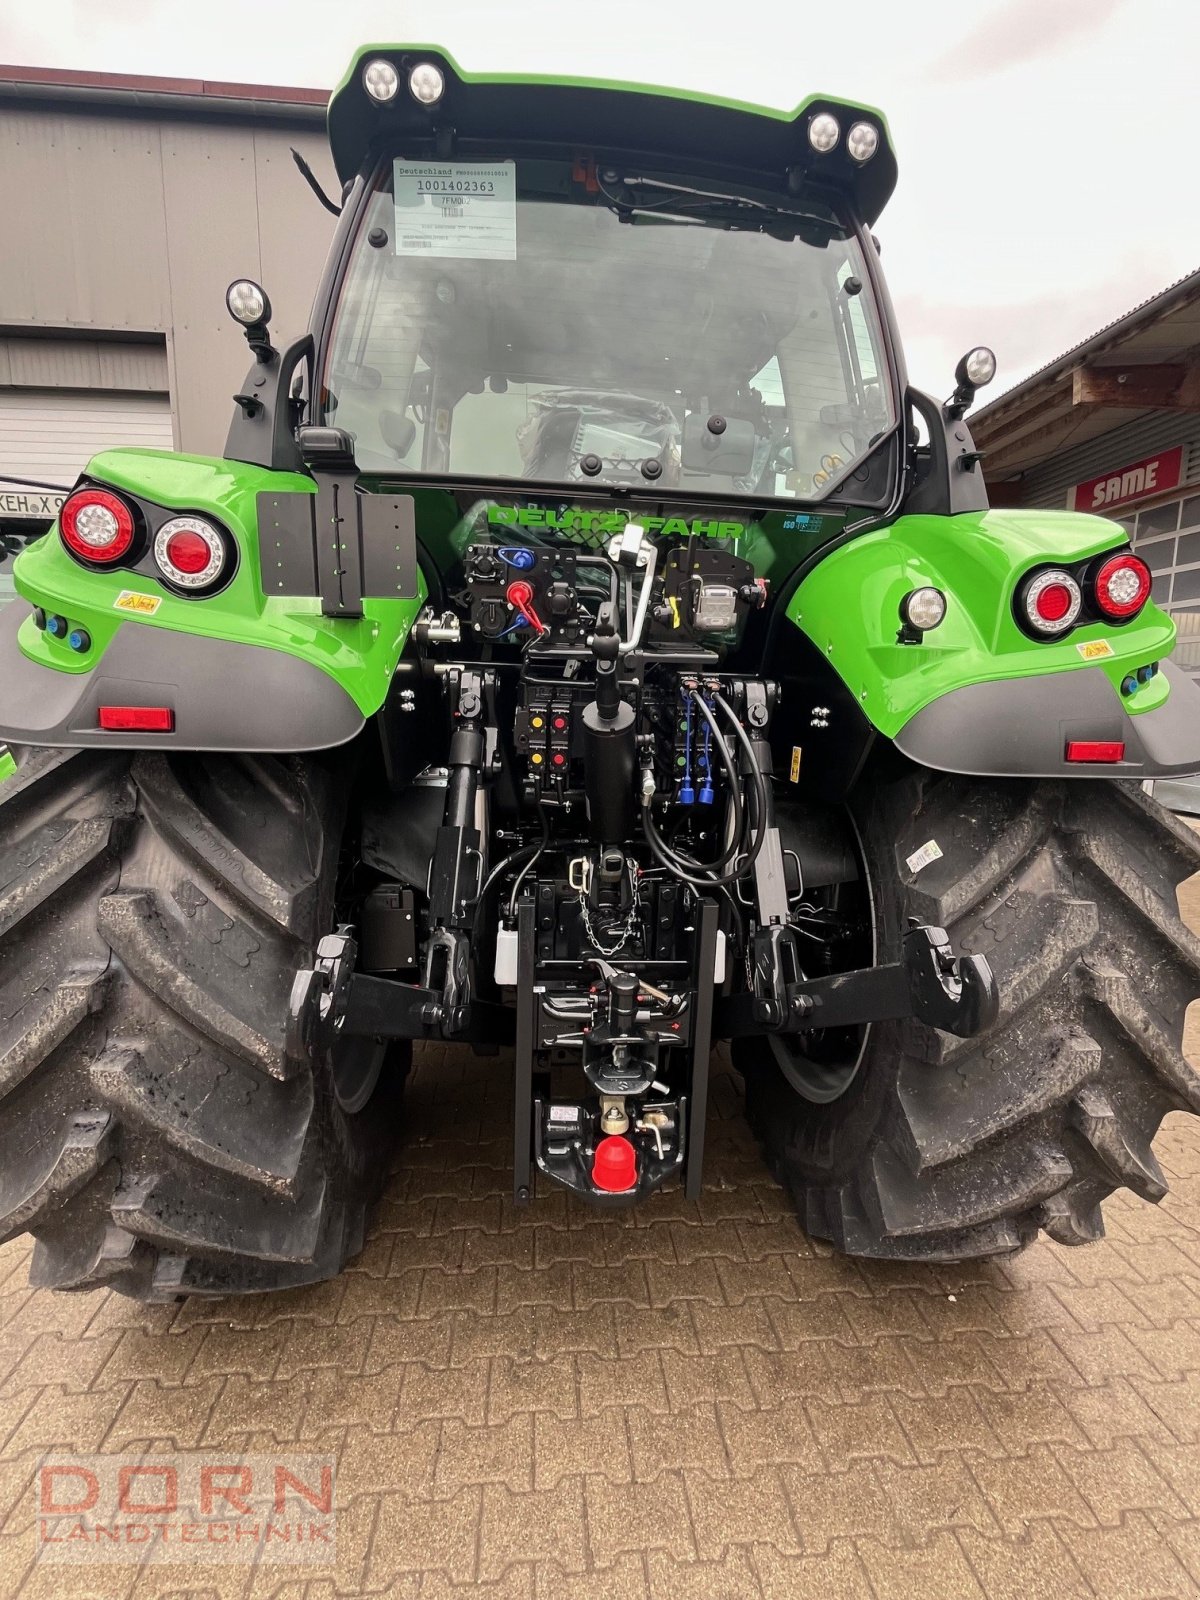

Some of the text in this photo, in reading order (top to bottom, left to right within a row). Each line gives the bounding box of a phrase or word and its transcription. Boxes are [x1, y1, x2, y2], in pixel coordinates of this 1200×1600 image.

[418, 180, 494, 191] 1001402363
[1092, 461, 1159, 507] SAME
[640, 516, 745, 539] FAHR
